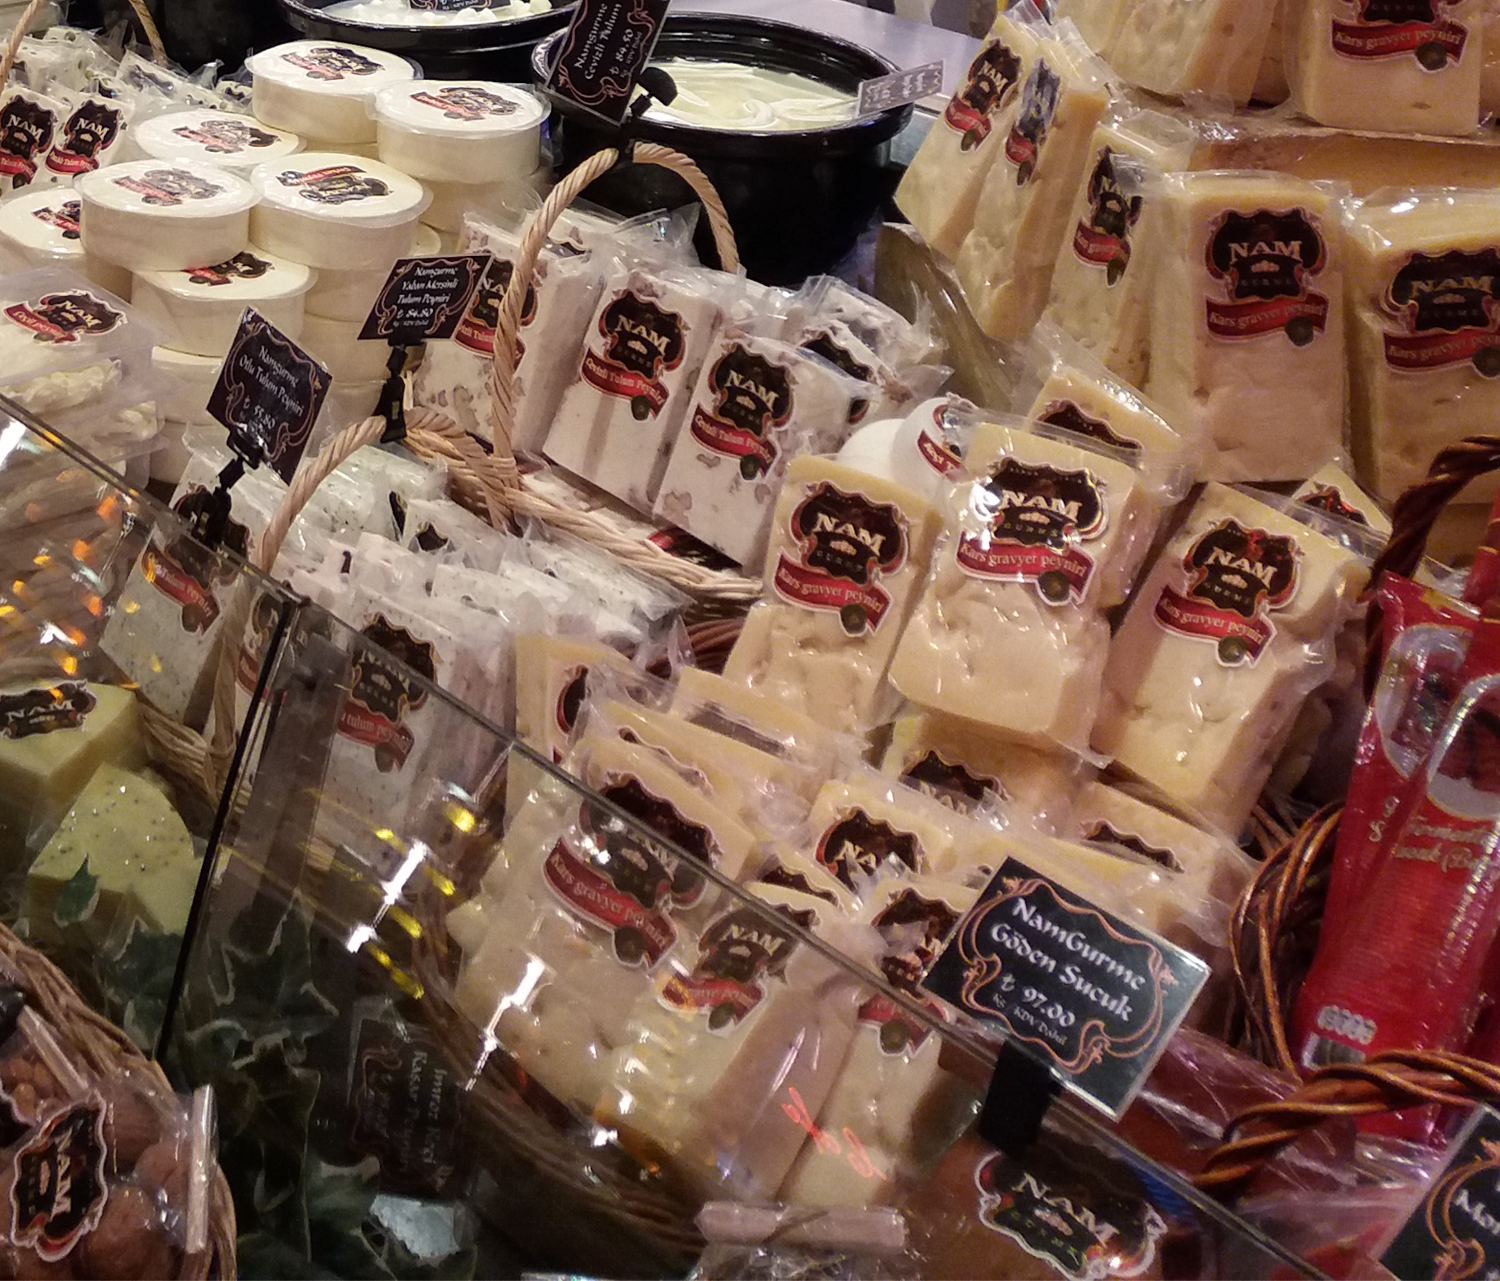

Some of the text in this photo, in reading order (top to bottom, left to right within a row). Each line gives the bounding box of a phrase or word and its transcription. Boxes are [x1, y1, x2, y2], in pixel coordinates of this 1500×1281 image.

[574, 2, 608, 69] Namgurme
[584, 3, 622, 80] Cevizli Tulum
[1335, 31, 1363, 48] Kars
[981, 60, 1008, 89] NAM
[6, 114, 45, 143] NAM
[75, 118, 110, 140] NAM
[1228, 240, 1303, 264] NAM
[397, 293, 452, 305] Tulum Peyniri
[1410, 276, 1496, 294] NAM
[58, 299, 102, 328] NAM
[1209, 311, 1238, 326] Kars
[614, 314, 671, 356] NAM
[1388, 344, 1418, 359] Kars
[239, 353, 305, 417] Otlu Tulum Peyniri
[258, 344, 299, 388] Namgurme
[725, 370, 779, 411] NAM
[998, 489, 1083, 524] NAM
[813, 512, 887, 558] NAM
[960, 543, 1087, 574] Kars gravyer peyniri
[1203, 546, 1278, 590] NAM
[777, 568, 884, 613] Kars gravyer peyniri
[1159, 598, 1263, 643] Kars gravyer peyniri
[551, 853, 575, 885] Kars
[720, 923, 785, 957] NAM
[1012, 897, 1146, 991] NamGurme
[990, 923, 1133, 1022] Göden Sucuk
[1021, 987, 1076, 1028] 97.00
[52, 1129, 73, 1216] NAM
[1012, 1171, 1120, 1248] NAM
